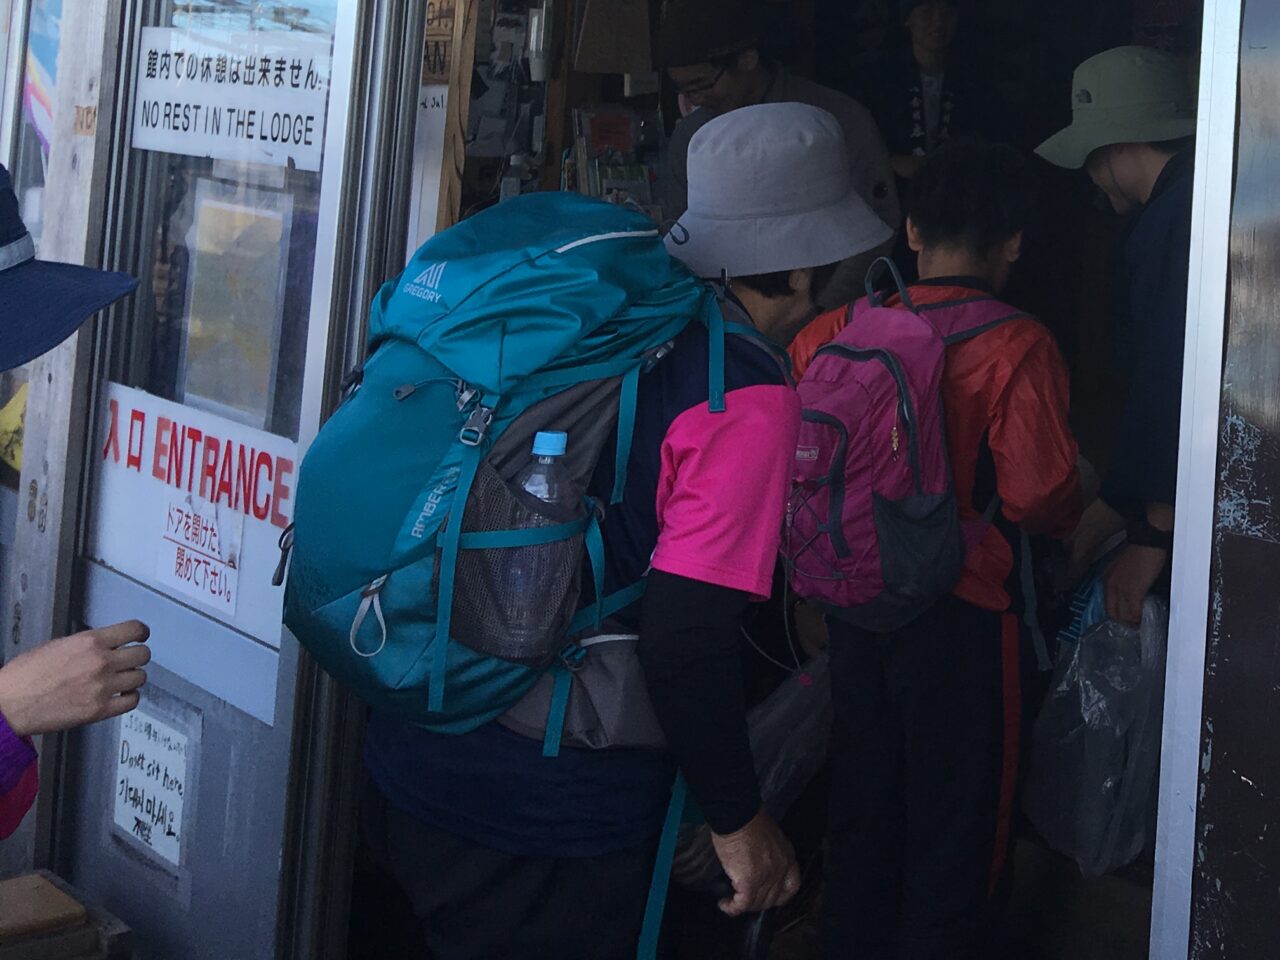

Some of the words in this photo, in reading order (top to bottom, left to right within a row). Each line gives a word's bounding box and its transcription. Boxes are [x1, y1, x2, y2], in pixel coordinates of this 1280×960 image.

[145, 48, 323, 91] 館内での休憩は出来ません。
[141, 99, 160, 129] NO
[163, 101, 202, 133] REST
[204, 105, 222, 136] IN
[227, 108, 256, 140] THE
[259, 110, 315, 146] LODGE
[403, 282, 442, 304] GREGORY
[103, 398, 146, 473] 入口
[152, 415, 294, 529] ENTRANCE
[175, 546, 231, 603] 閉めて下さい。
